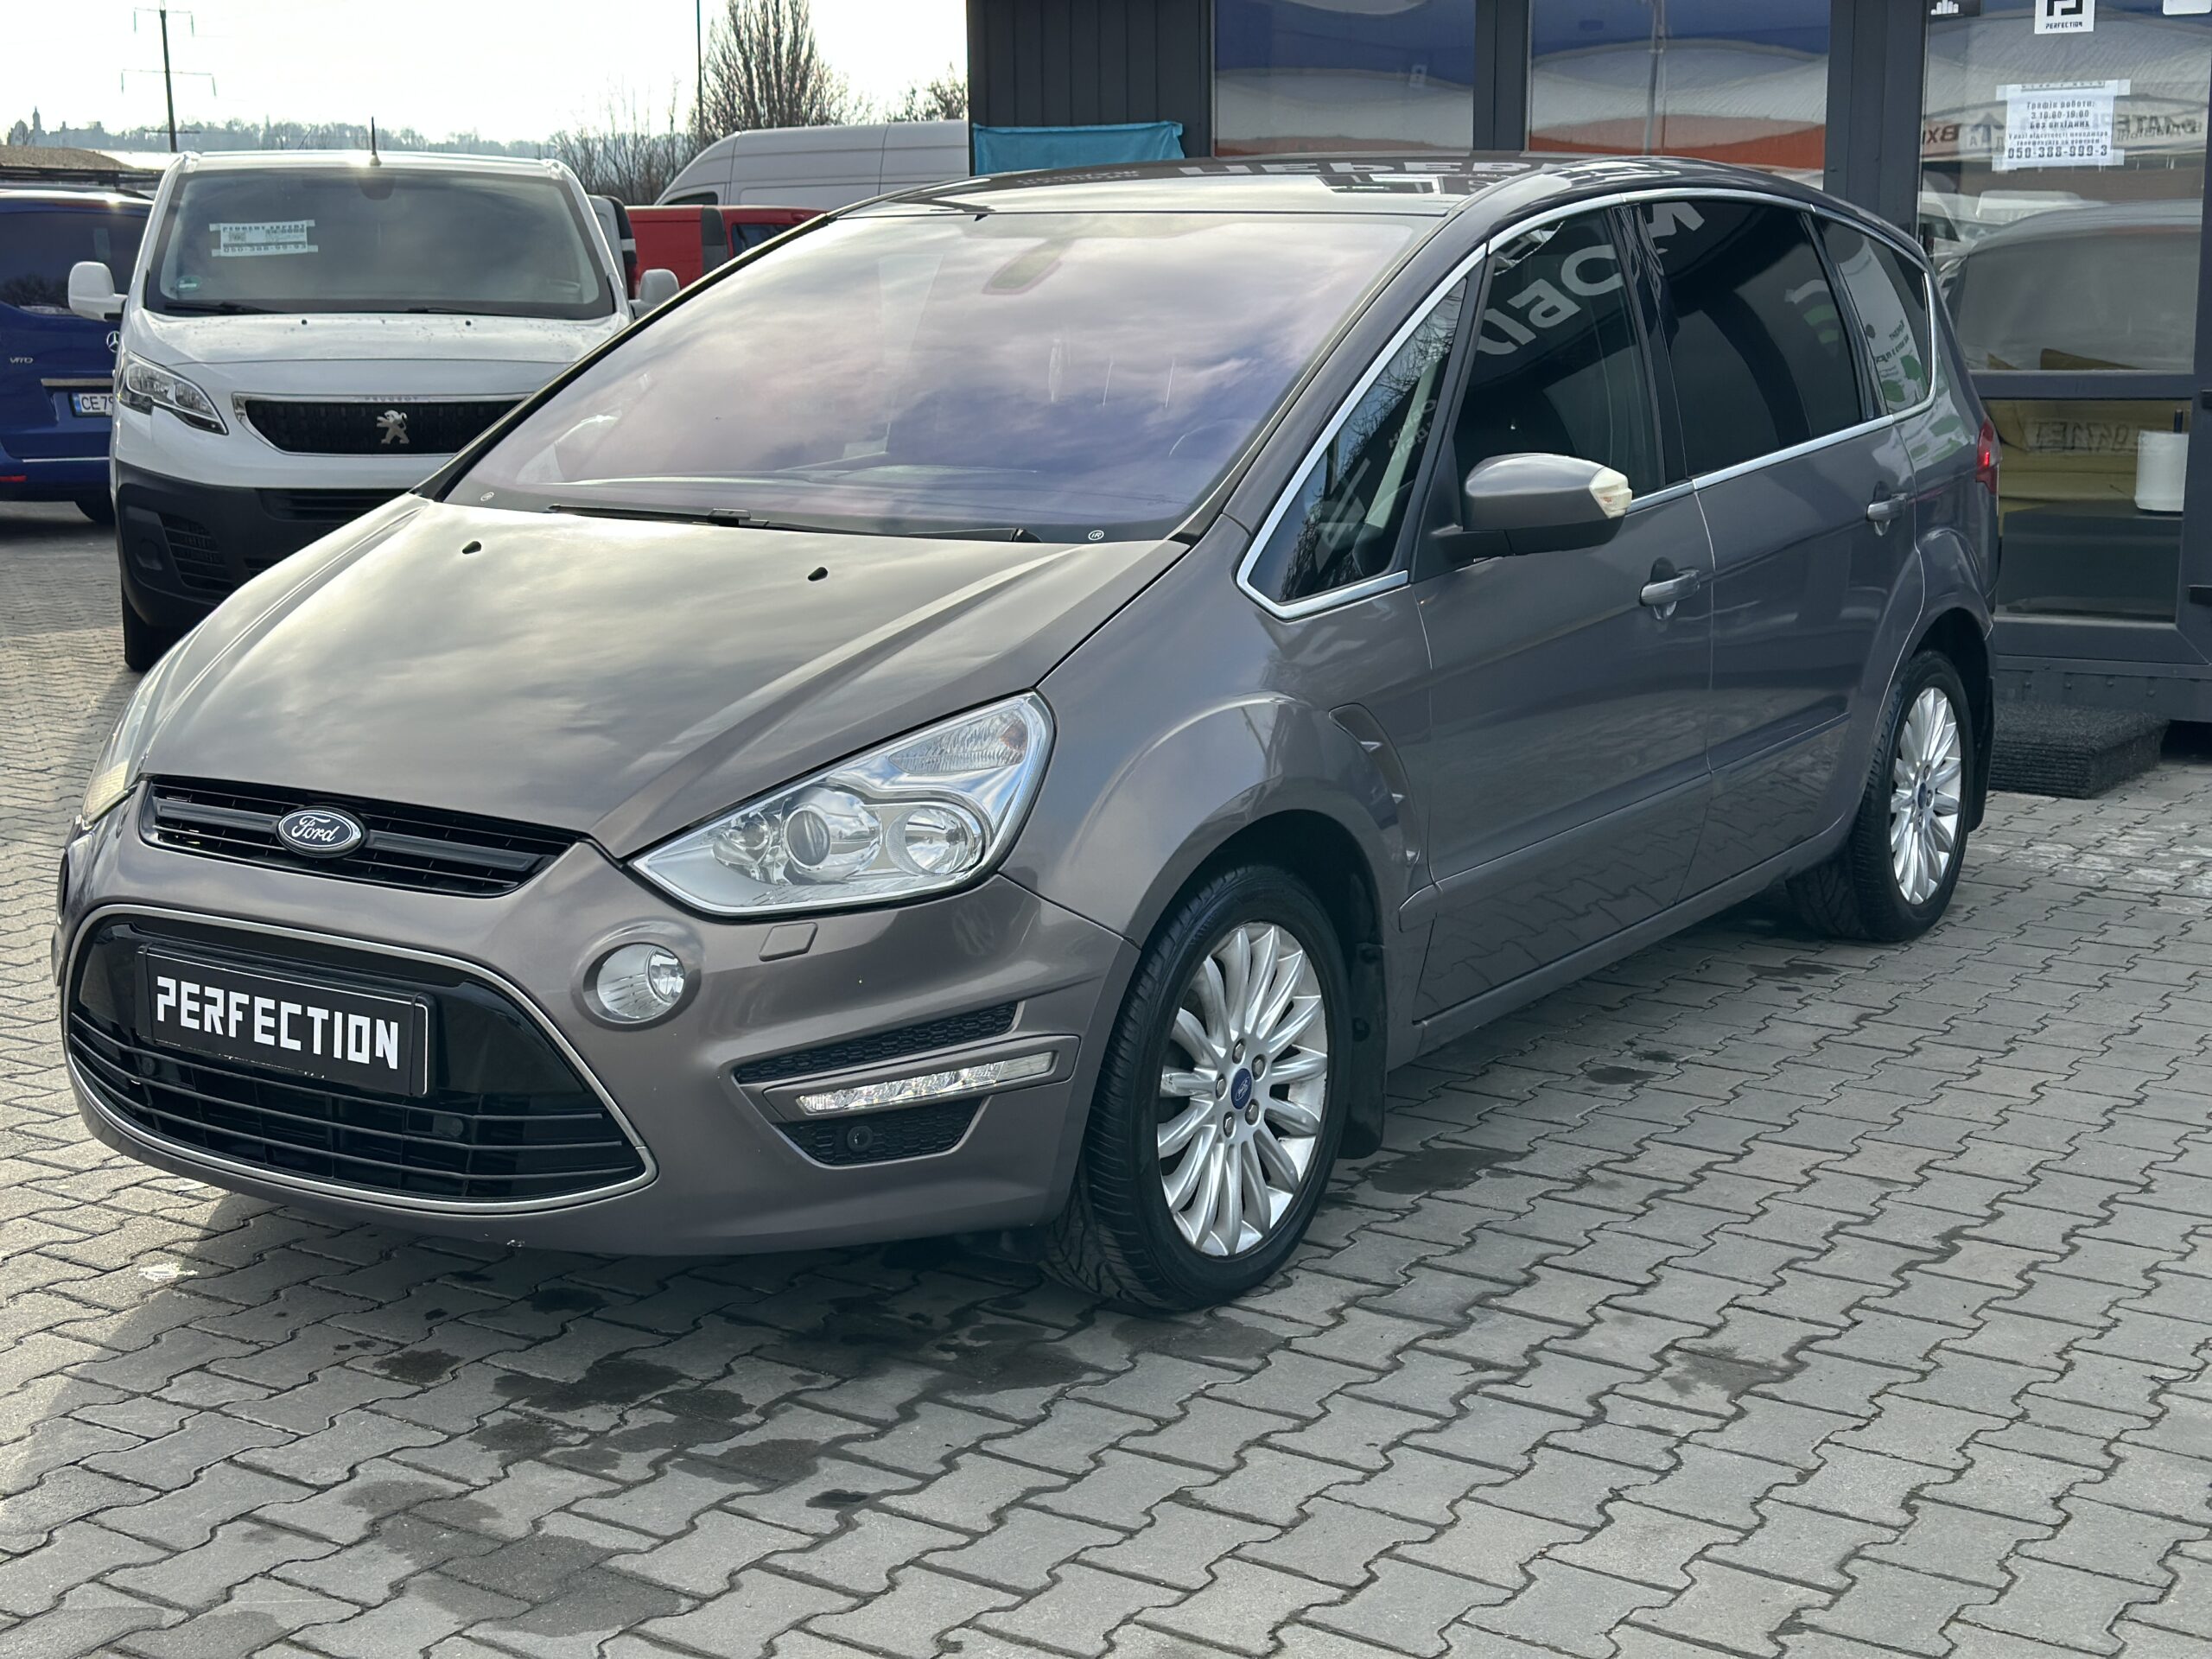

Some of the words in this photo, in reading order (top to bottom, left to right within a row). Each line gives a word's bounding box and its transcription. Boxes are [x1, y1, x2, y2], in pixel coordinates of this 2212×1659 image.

[2045, 21, 2082, 29] PERFECTION
[2008, 144, 2107, 159] 050-388-999-3
[291, 815, 340, 842] Ford
[157, 976, 399, 1070] PERFECTION
